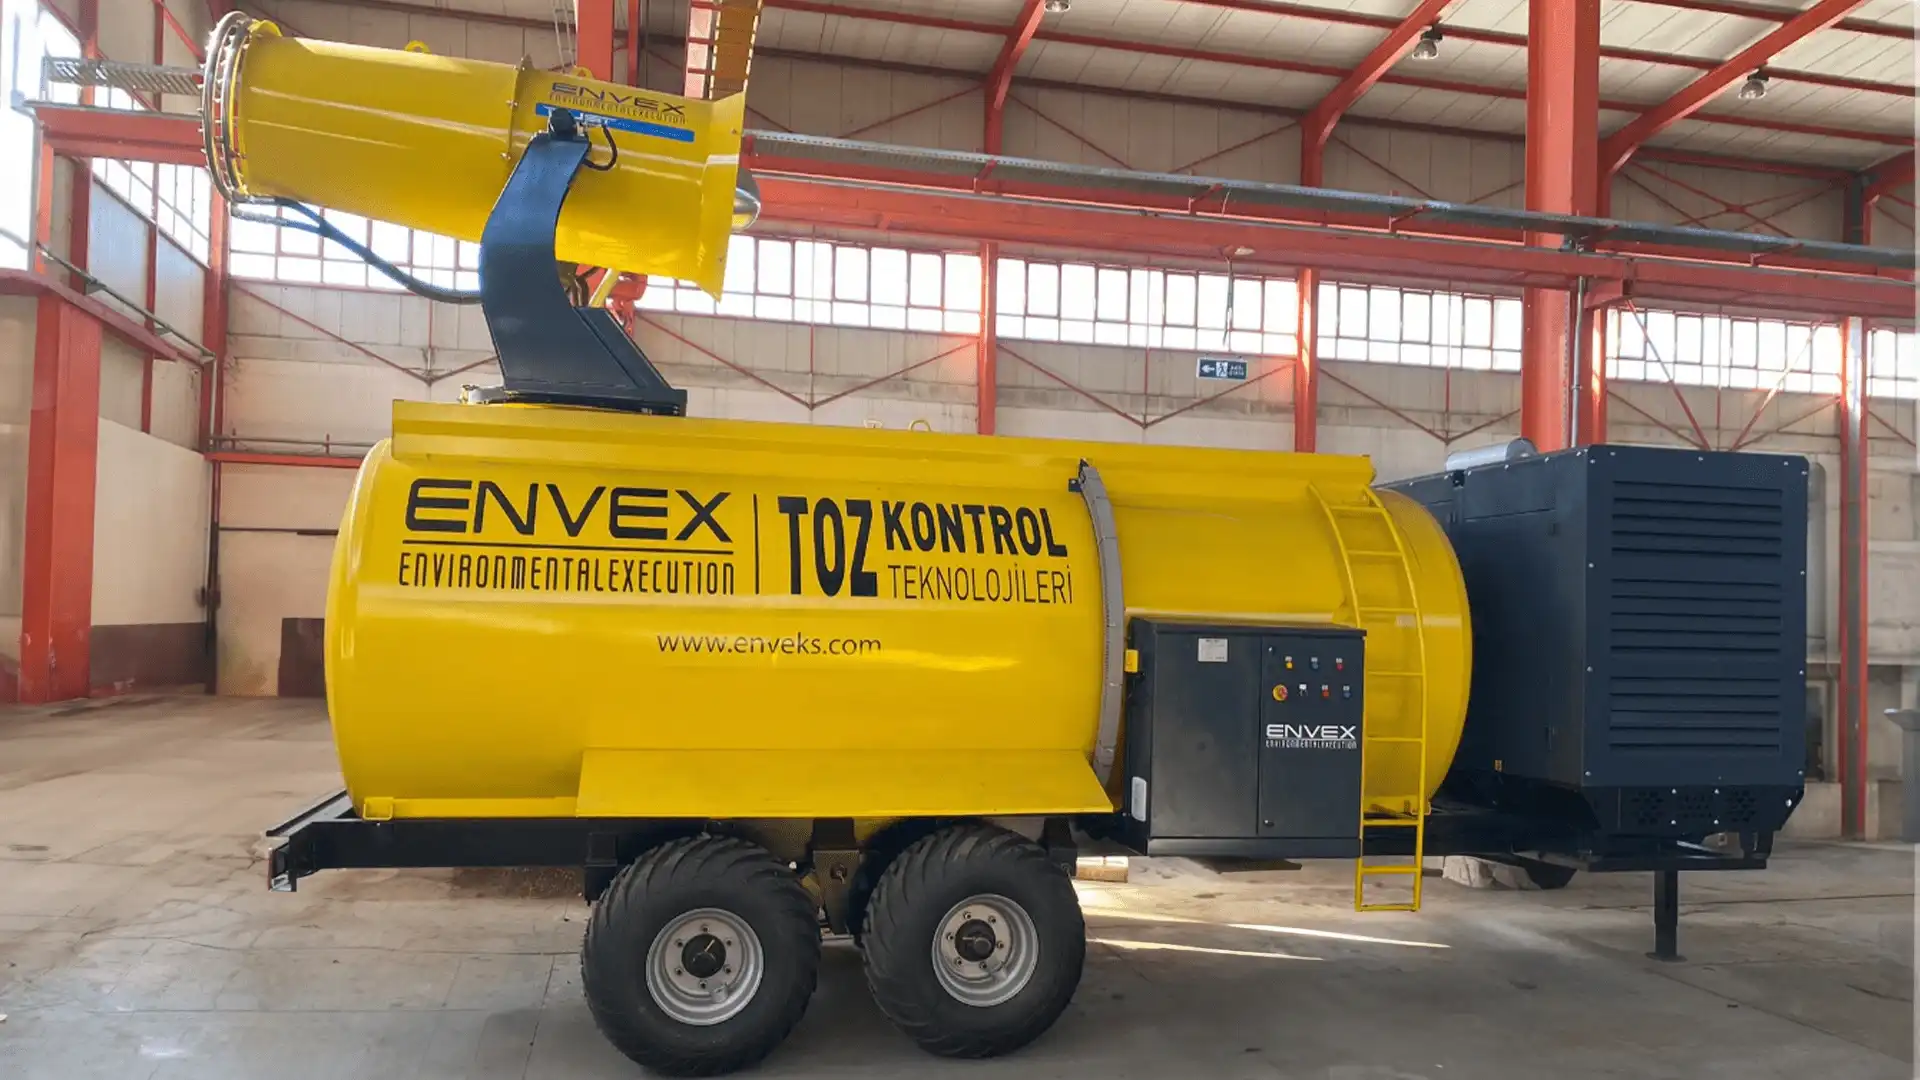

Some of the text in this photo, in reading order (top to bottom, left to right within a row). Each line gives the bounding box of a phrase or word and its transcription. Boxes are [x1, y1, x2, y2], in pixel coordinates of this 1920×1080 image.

[552, 82, 685, 115] ENVEX
[405, 478, 733, 542] ENVEX
[778, 495, 1068, 597] TOZ KONTROL
[399, 552, 734, 595] ENVIRONMENTALEXECUTION
[888, 563, 1073, 604] TEKNOLOJİLERİ
[657, 631, 881, 655] www.enveks.com
[1266, 724, 1356, 739] ENVEX
